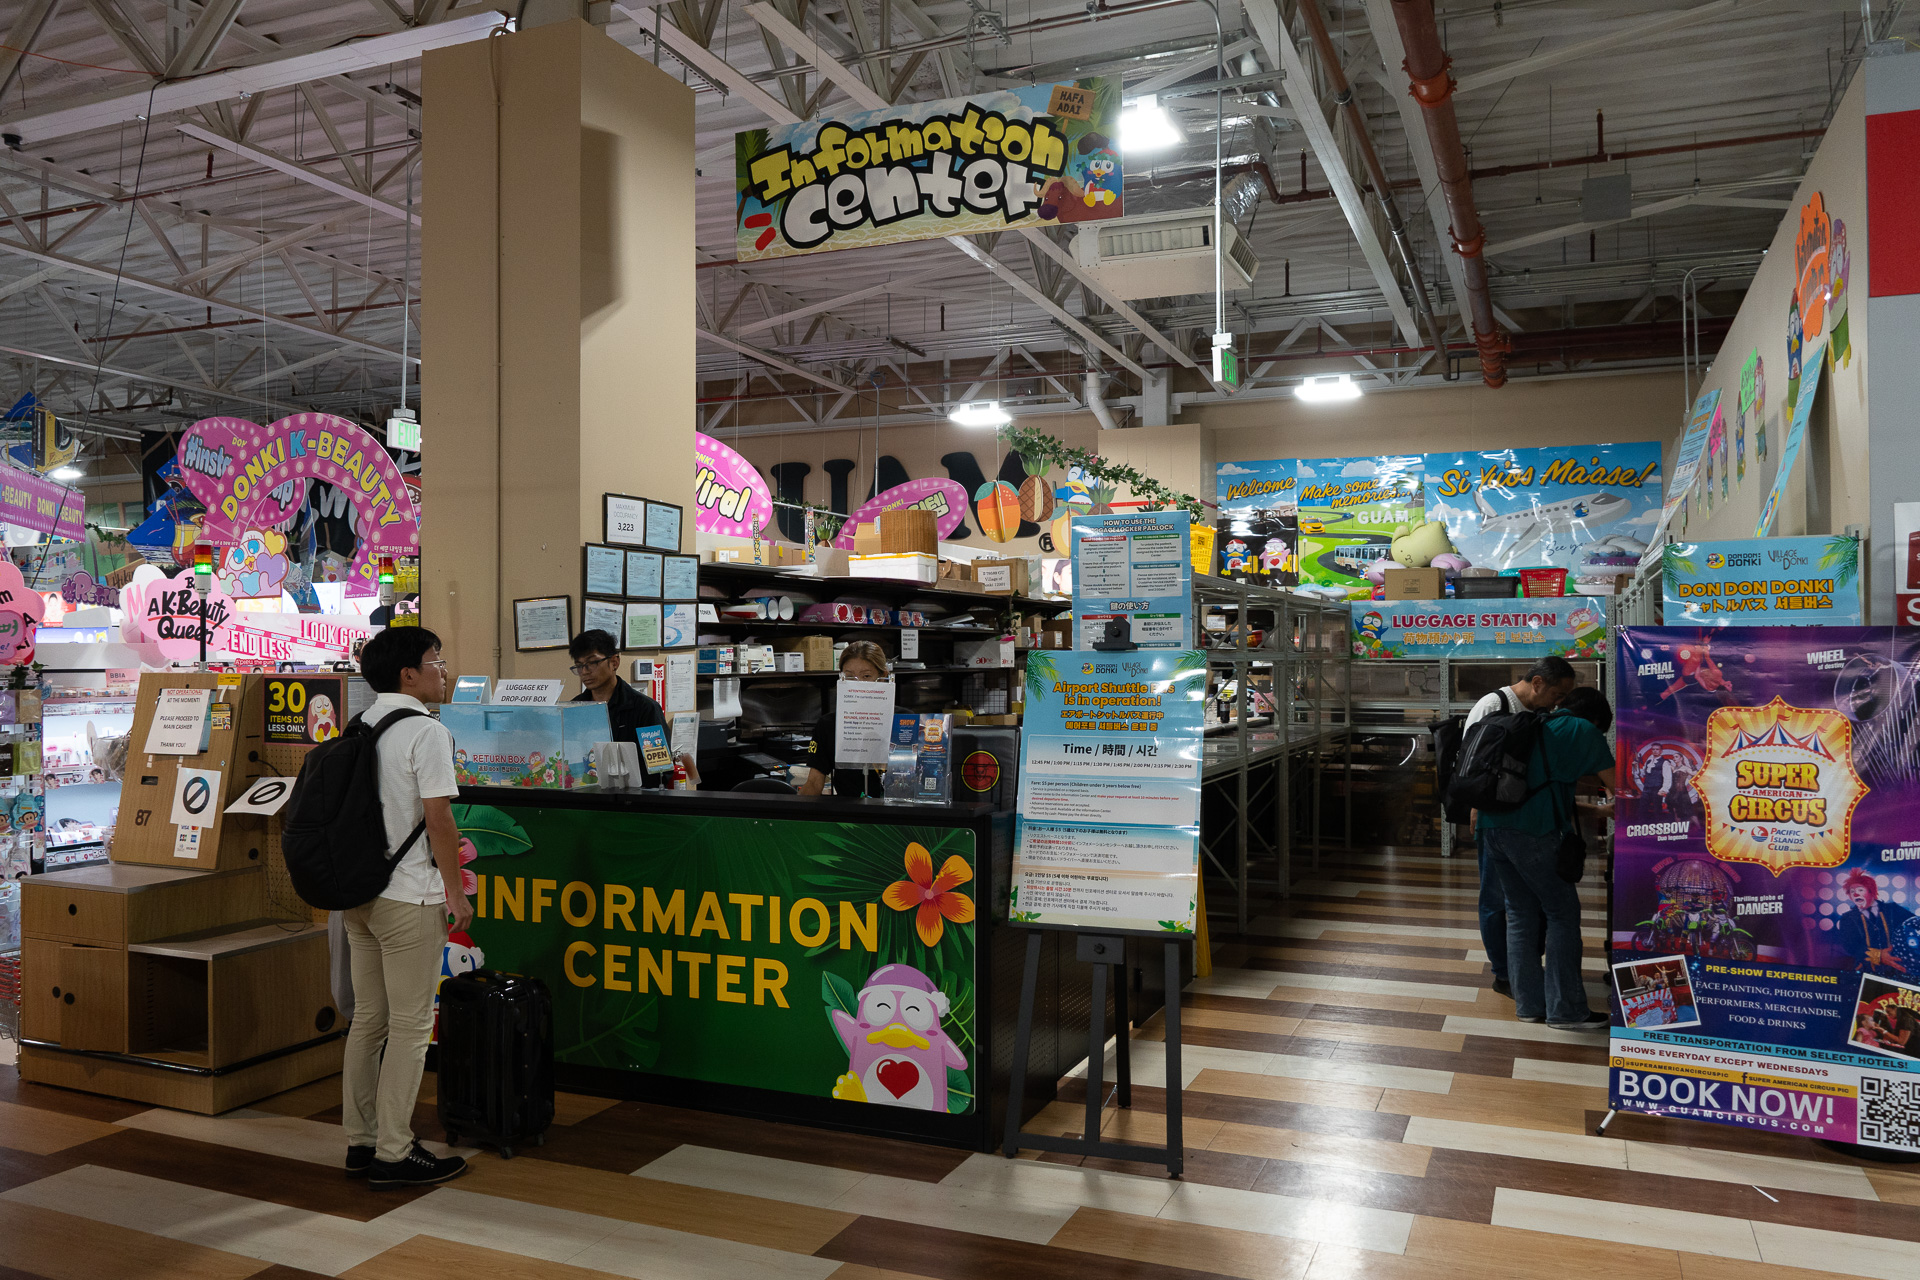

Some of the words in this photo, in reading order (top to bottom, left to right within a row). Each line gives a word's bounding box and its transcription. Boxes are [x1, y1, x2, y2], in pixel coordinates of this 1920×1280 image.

[1060, 90, 1085, 104] HAFA
[1057, 102, 1082, 115] ADAI
[749, 107, 1067, 203] Information
[398, 421, 418, 449] EXIT
[220, 437, 286, 522] DONKI
[290, 429, 402, 528] K-BEAUTY
[1438, 468, 1473, 498] Si
[1539, 456, 1658, 489] Ma'ase!
[1226, 476, 1297, 502] Welcome
[1299, 482, 1342, 502] Make
[1344, 478, 1380, 494] some
[37, 497, 55, 518] DONKI
[613, 511, 638, 520] OCCUPANCY
[1357, 510, 1409, 526] GUAM
[617, 523, 634, 532] 3,223
[1143, 524, 1174, 532] PADLOCK
[1728, 559, 1762, 567] DONKI
[1768, 549, 1798, 563] VILLAGE
[1783, 555, 1809, 571] DONKI
[1679, 582, 1722, 598] DON
[1724, 581, 1767, 596] DON
[1771, 578, 1835, 595] DONKI
[1110, 601, 1150, 611] 鍵の使い方
[1775, 595, 1833, 610] 셔틀버스
[1391, 613, 1476, 629] LUGGAGE
[1480, 612, 1557, 628] STATION
[301, 619, 337, 644] LOOK
[1403, 632, 1475, 645] 荷物預かり所
[1494, 631, 1507, 644] 짐
[1509, 631, 1546, 644] 보관소
[260, 637, 293, 661] LESS
[1806, 648, 1847, 665] WHEEL
[654, 669, 663, 679] FIRE
[1131, 666, 1149, 677] DONKI
[1637, 661, 1675, 677] AERIAL
[1824, 661, 1845, 671] destiny
[1657, 672, 1675, 680] Straps
[1053, 681, 1100, 696] Airport
[1101, 681, 1148, 694] Shuttle
[268, 681, 306, 713] 30
[1064, 694, 1076, 705] is
[1077, 695, 1090, 706] in
[1091, 695, 1162, 709] operation!
[270, 715, 292, 723] ITEMS
[293, 716, 304, 724] OR
[1061, 710, 1164, 720] エアポートシャトルバス運行中
[268, 724, 286, 732] LESS
[286, 725, 306, 733] ONLY
[1065, 721, 1097, 730] 에어포트
[1098, 722, 1129, 731] 셔틀버스
[1131, 722, 1147, 731] 운행
[646, 751, 668, 761] OPEN
[1063, 743, 1092, 755] Time
[1102, 744, 1126, 756] 時間
[1136, 745, 1159, 757] 시간
[472, 754, 507, 763] RETURN
[508, 755, 526, 764] BOX
[1735, 759, 1820, 791] SUPER
[1752, 789, 1803, 798] AMERICAN
[135, 809, 152, 826] 87
[1729, 795, 1827, 827] CIRCUS
[1626, 821, 1690, 838] CROSSBOW
[1770, 827, 1801, 837] PACIFIC
[1767, 842, 1790, 852] CLUB
[1770, 835, 1804, 845] ISLANDS
[1733, 895, 1758, 903] Thrilling
[1759, 894, 1776, 903] globe
[476, 873, 879, 953] INFORMATION
[1736, 901, 1783, 916] DANGER
[563, 939, 791, 1010] CENTER
[1705, 964, 1763, 978] PRE-SHOW
[1765, 970, 1838, 985] EXPERIENCE
[1695, 980, 1721, 991] FACE
[1722, 982, 1773, 996] PAINTING,
[1774, 987, 1813, 1000] PHOTOS
[1814, 991, 1842, 1003] WITH
[1695, 996, 1763, 1011] PERFORMERS,
[1765, 1002, 1841, 1019] MERCHANDISE,
[1728, 1014, 1756, 1025] FOOD
[1757, 1016, 1765, 1026] &
[1766, 1017, 1806, 1030] DRINKS
[1643, 1031, 1670, 1042] FREE
[1672, 1033, 1773, 1053] TRANSPORTATION
[1775, 1046, 1807, 1057] FROM
[1810, 1049, 1854, 1063] SELECT
[1858, 1055, 1908, 1069] HOTELS!
[1620, 1045, 1656, 1056] SHOWS
[1658, 1048, 1711, 1063] EVERYDAY
[1714, 1055, 1754, 1067] EXCEPT
[1757, 1061, 1829, 1077] WEDNESDAYS
[1625, 1060, 1729, 1079] @SUPERAMERICANCIRCUSPIC
[1748, 1075, 1772, 1084] SUPER
[1773, 1078, 1808, 1088] AMERICAN
[1809, 1082, 1836, 1091] CIRCUS
[1618, 1070, 1721, 1109] BOOK
[1731, 1085, 1834, 1124] NOW!
[1622, 1098, 1825, 1134] WWW.GUAMCIRCUS.COM
